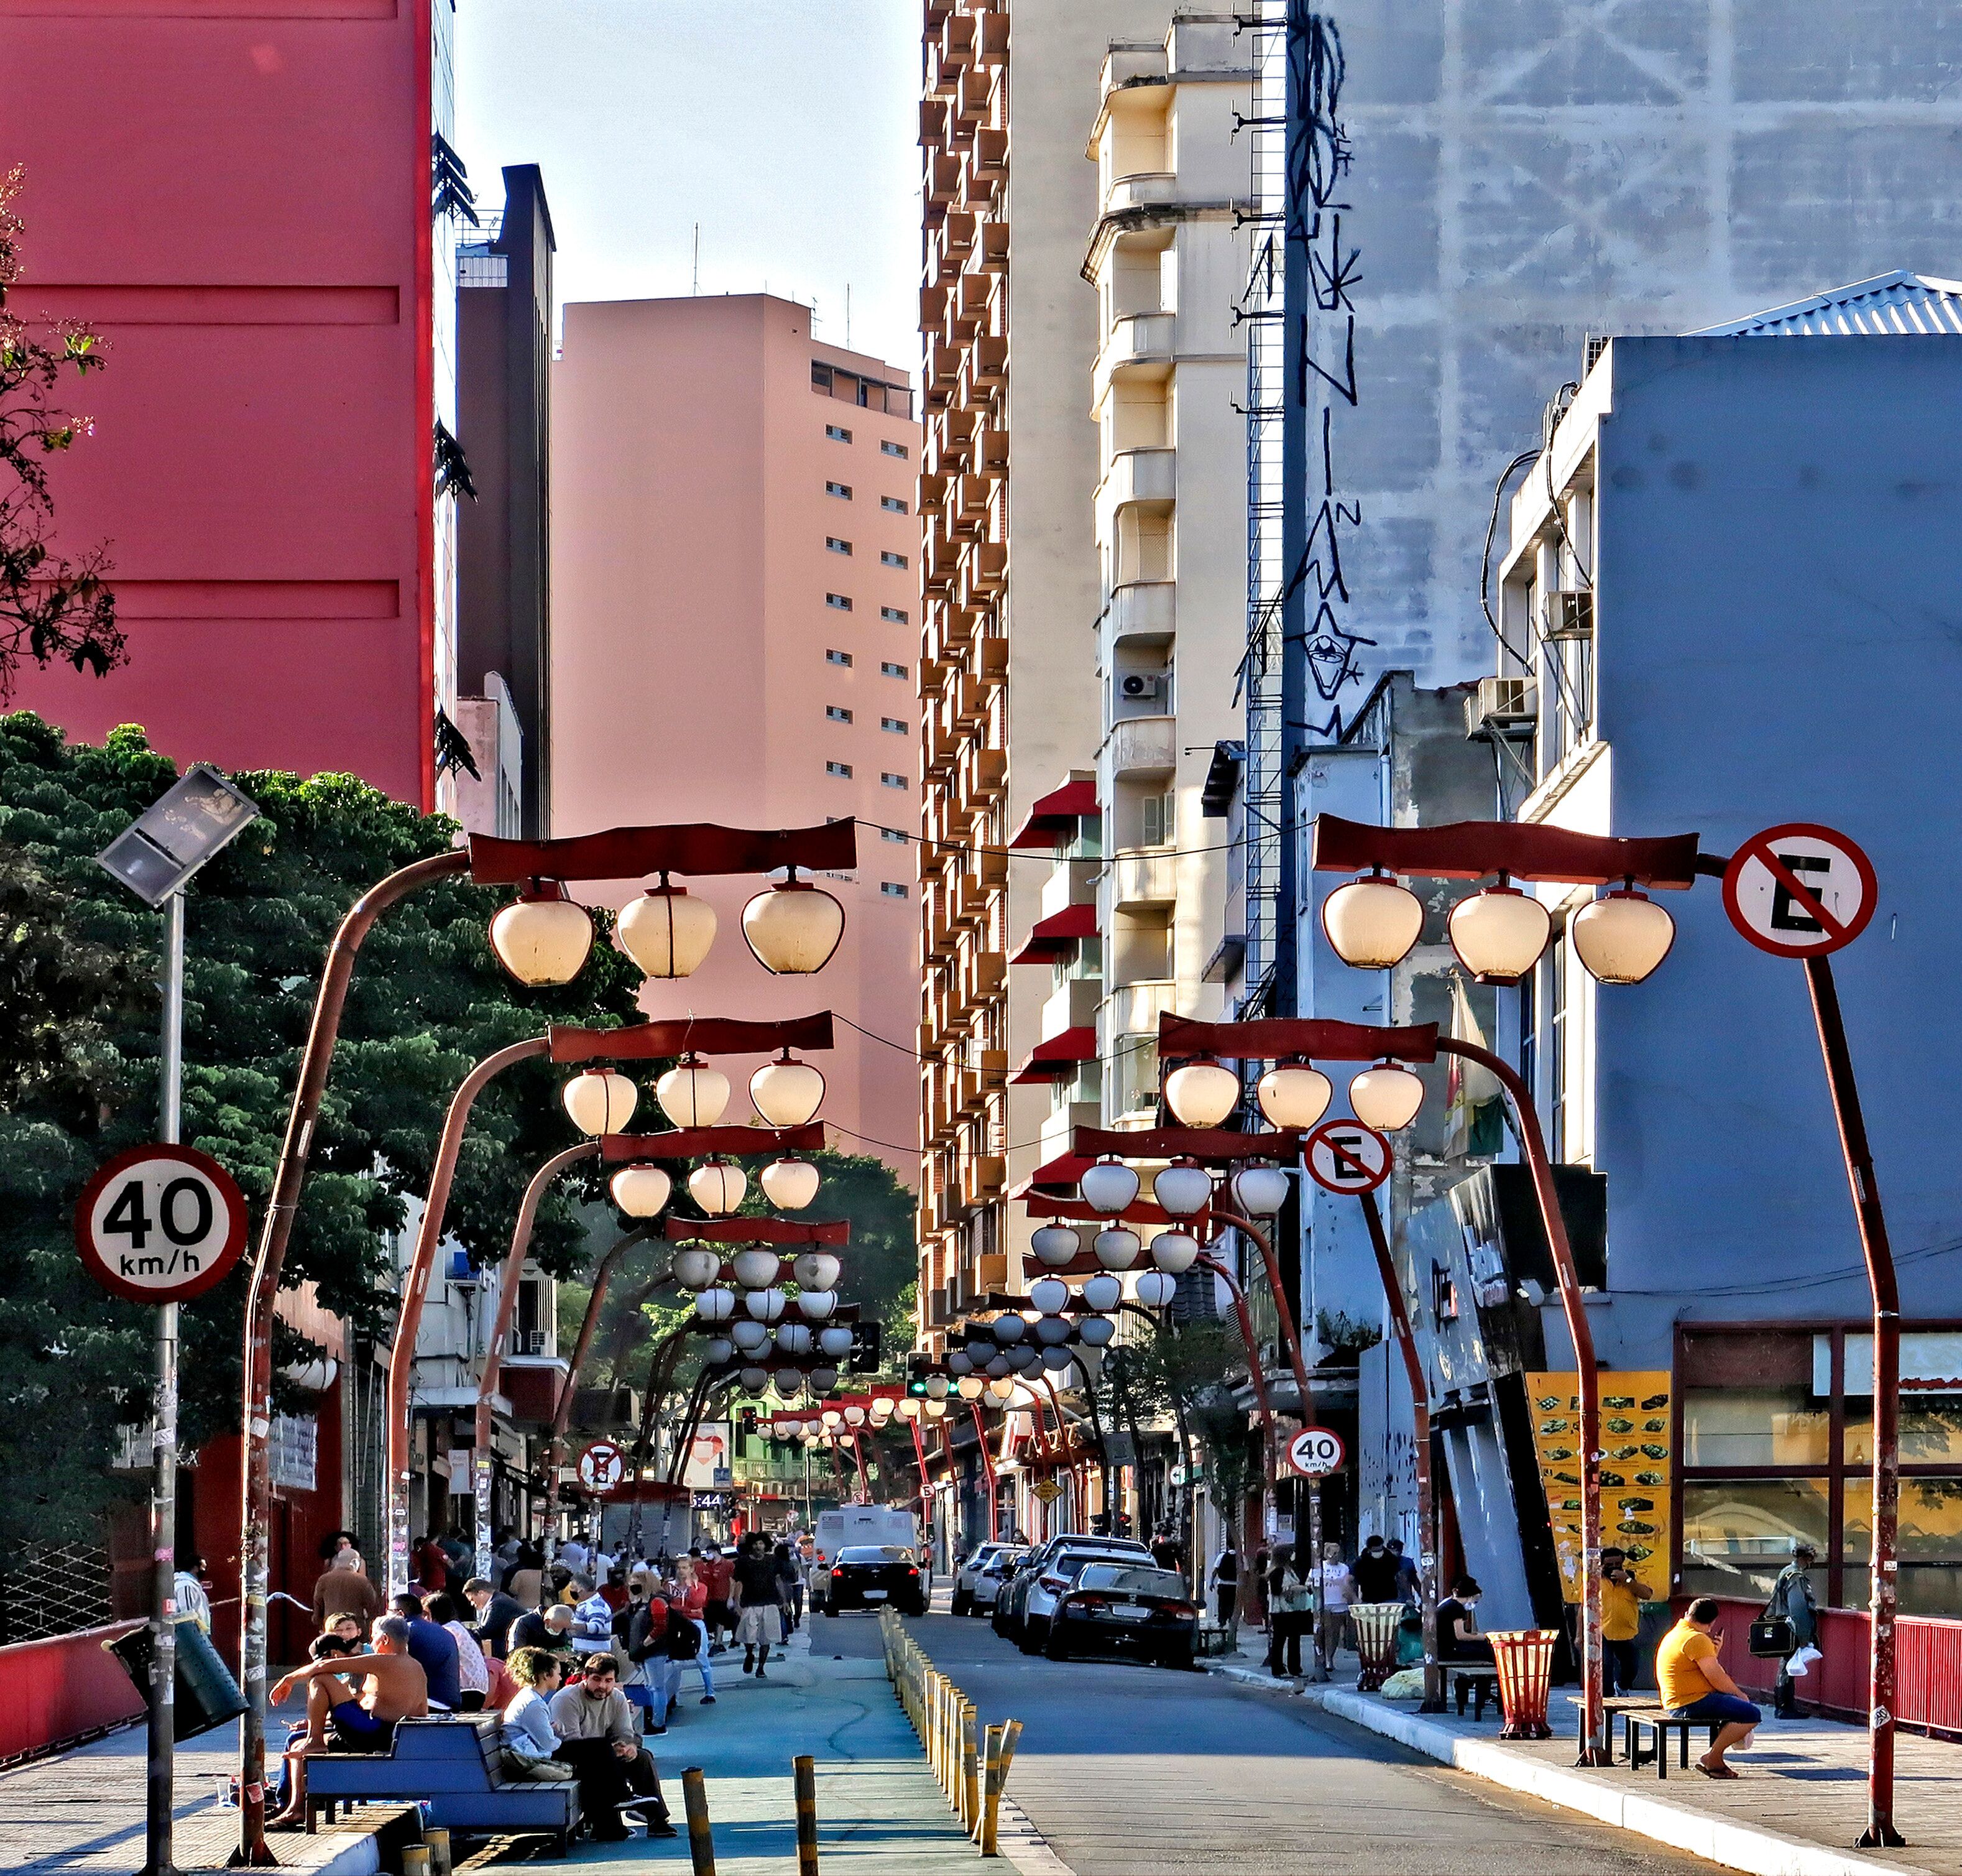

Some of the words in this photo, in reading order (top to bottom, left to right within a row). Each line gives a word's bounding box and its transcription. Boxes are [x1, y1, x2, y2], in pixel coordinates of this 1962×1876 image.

[1771, 854, 1831, 933] E
[1331, 1136, 1366, 1179] E
[103, 1177, 213, 1249] 40
[120, 1249, 200, 1276] km/h
[1296, 1439, 1335, 1459] 40
